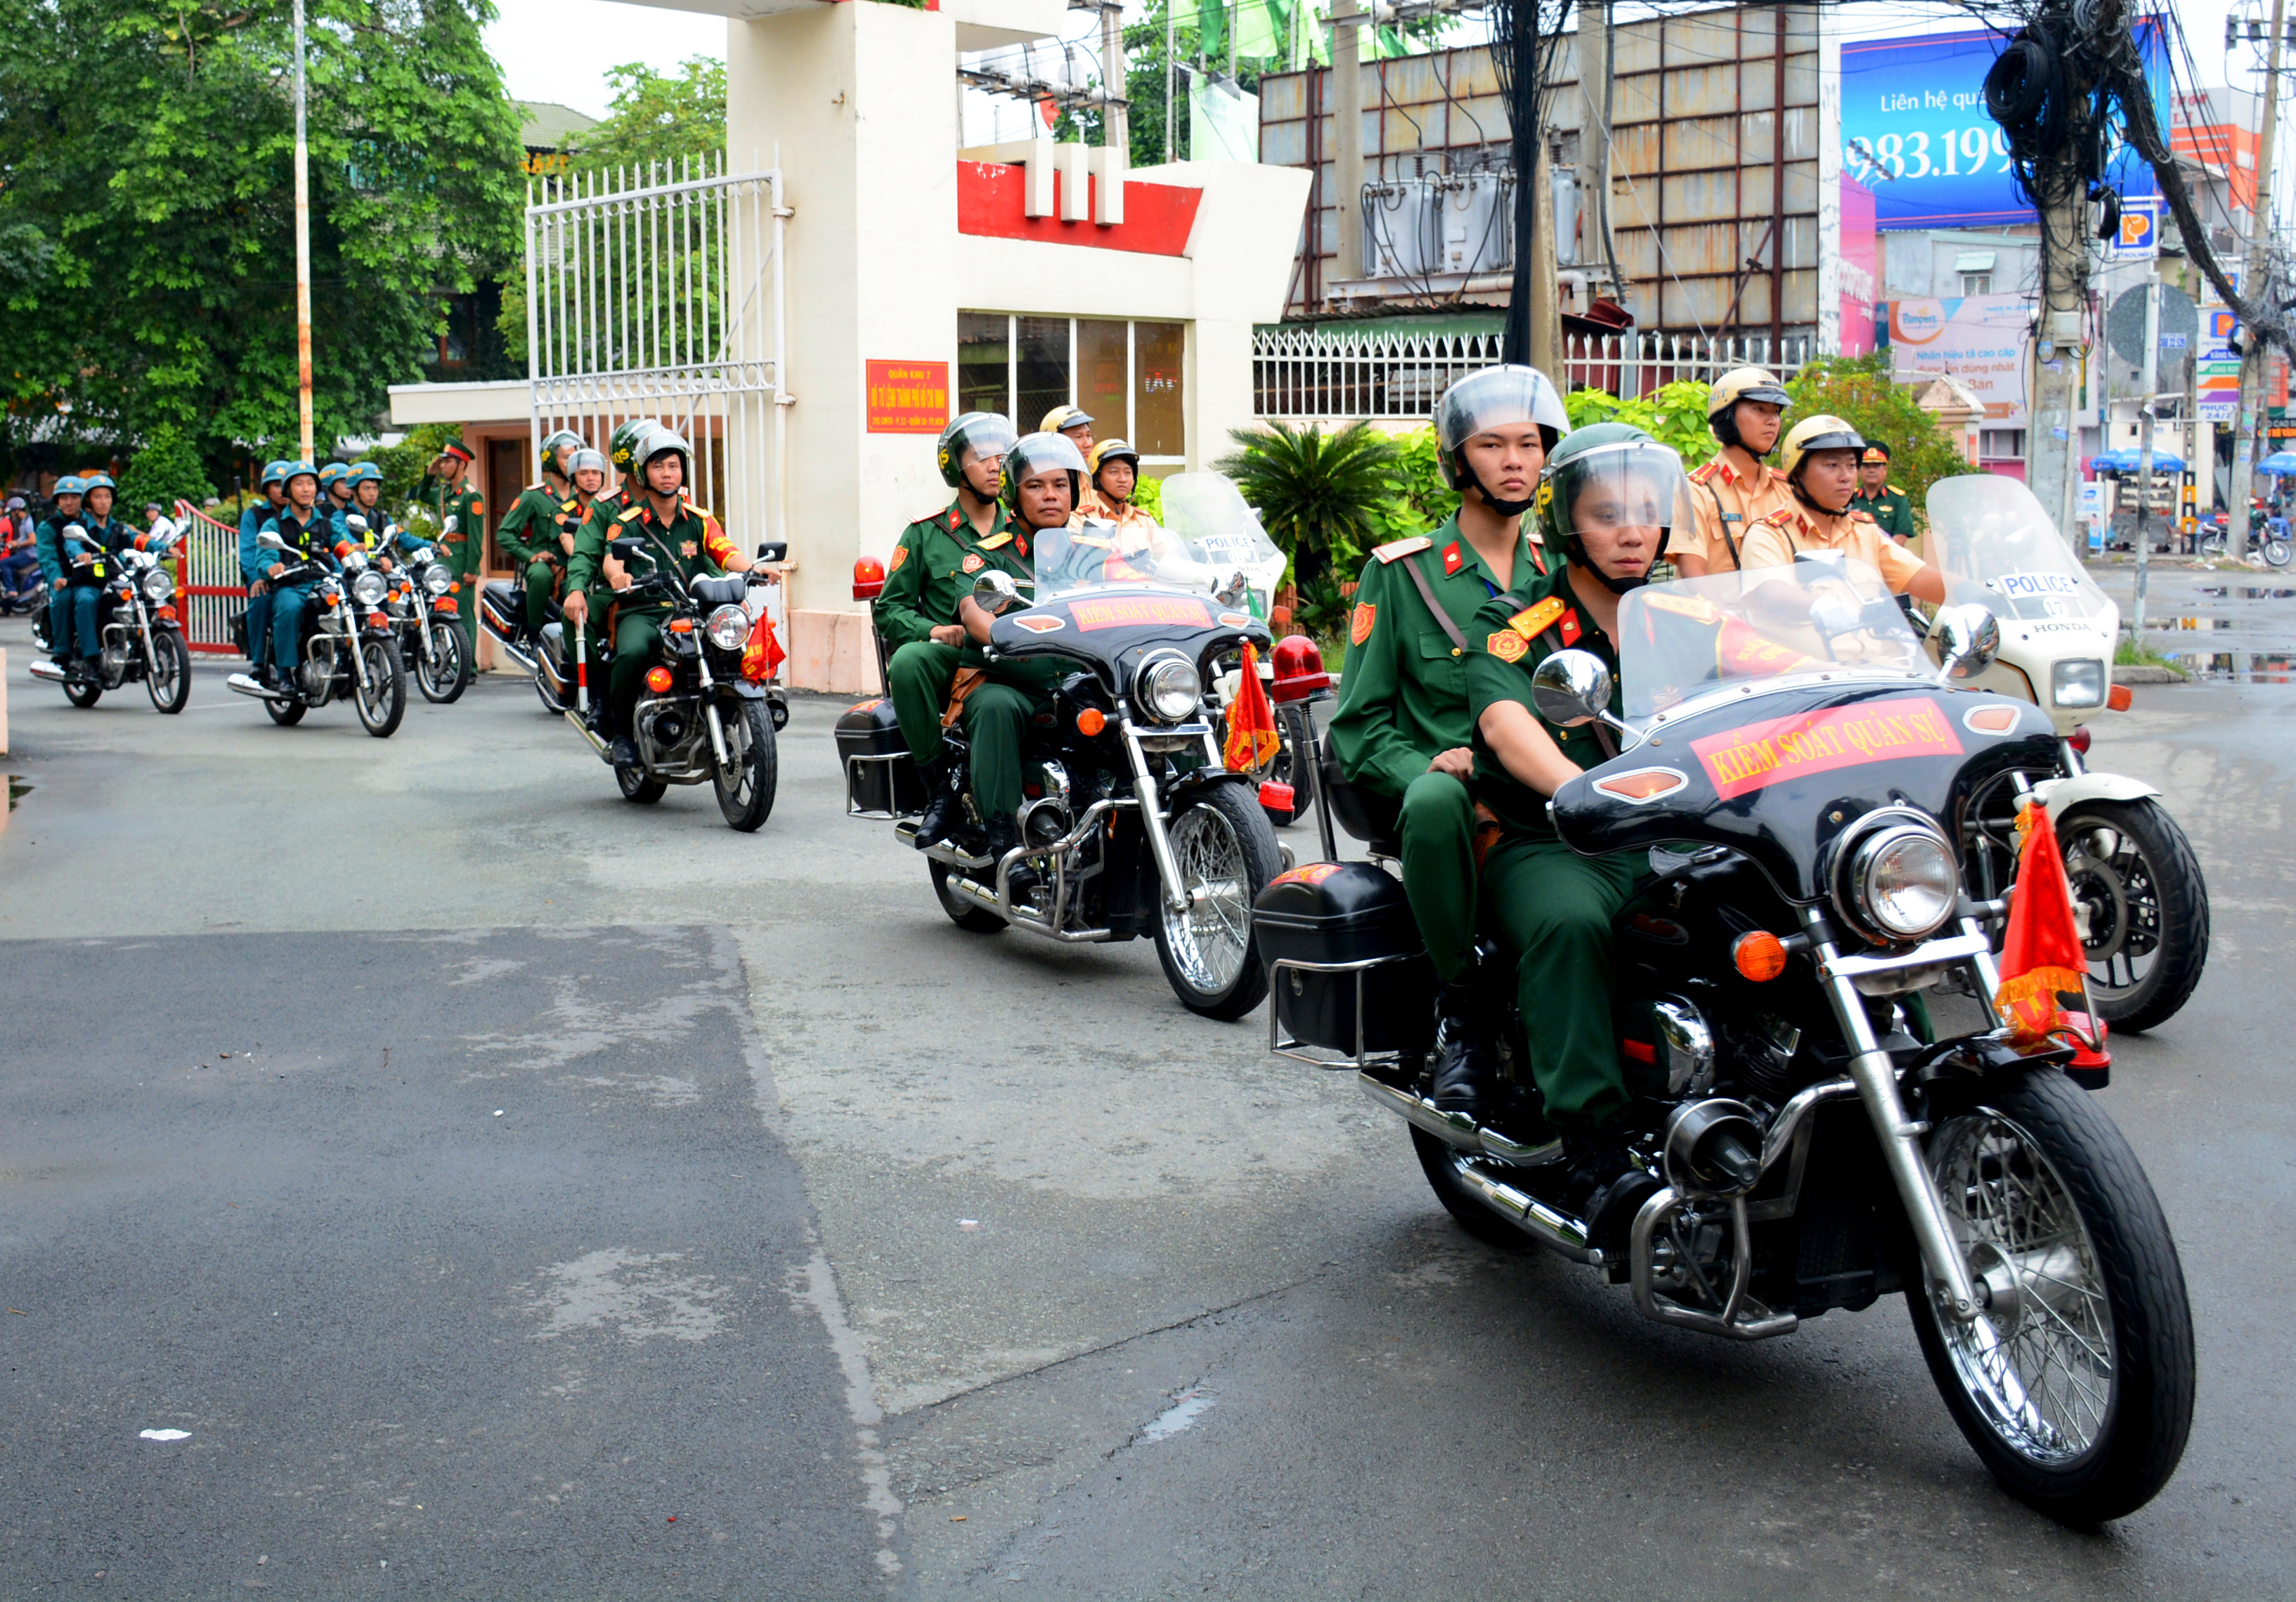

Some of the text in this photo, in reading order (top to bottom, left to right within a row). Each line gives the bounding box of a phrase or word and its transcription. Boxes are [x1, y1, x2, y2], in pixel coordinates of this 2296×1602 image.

[1881, 94, 1919, 112] Liên
[1925, 90, 1947, 111] hệ
[1903, 312, 1937, 325] Pampers
[1917, 351, 1941, 359] Nhãn
[1944, 350, 1963, 361] hiệu
[1978, 349, 1995, 358] cao
[926, 370, 931, 380] 7
[1205, 537, 1251, 549] POLICE
[2004, 575, 2074, 595] POLICE
[1114, 600, 1150, 620] SOÁT
[1150, 600, 1188, 621] QUÂN
[2046, 602, 2064, 615] 17
[2033, 623, 2093, 633] HONDA
[1708, 706, 1949, 785] KIỂM SOÁT QUÂN SỰ
